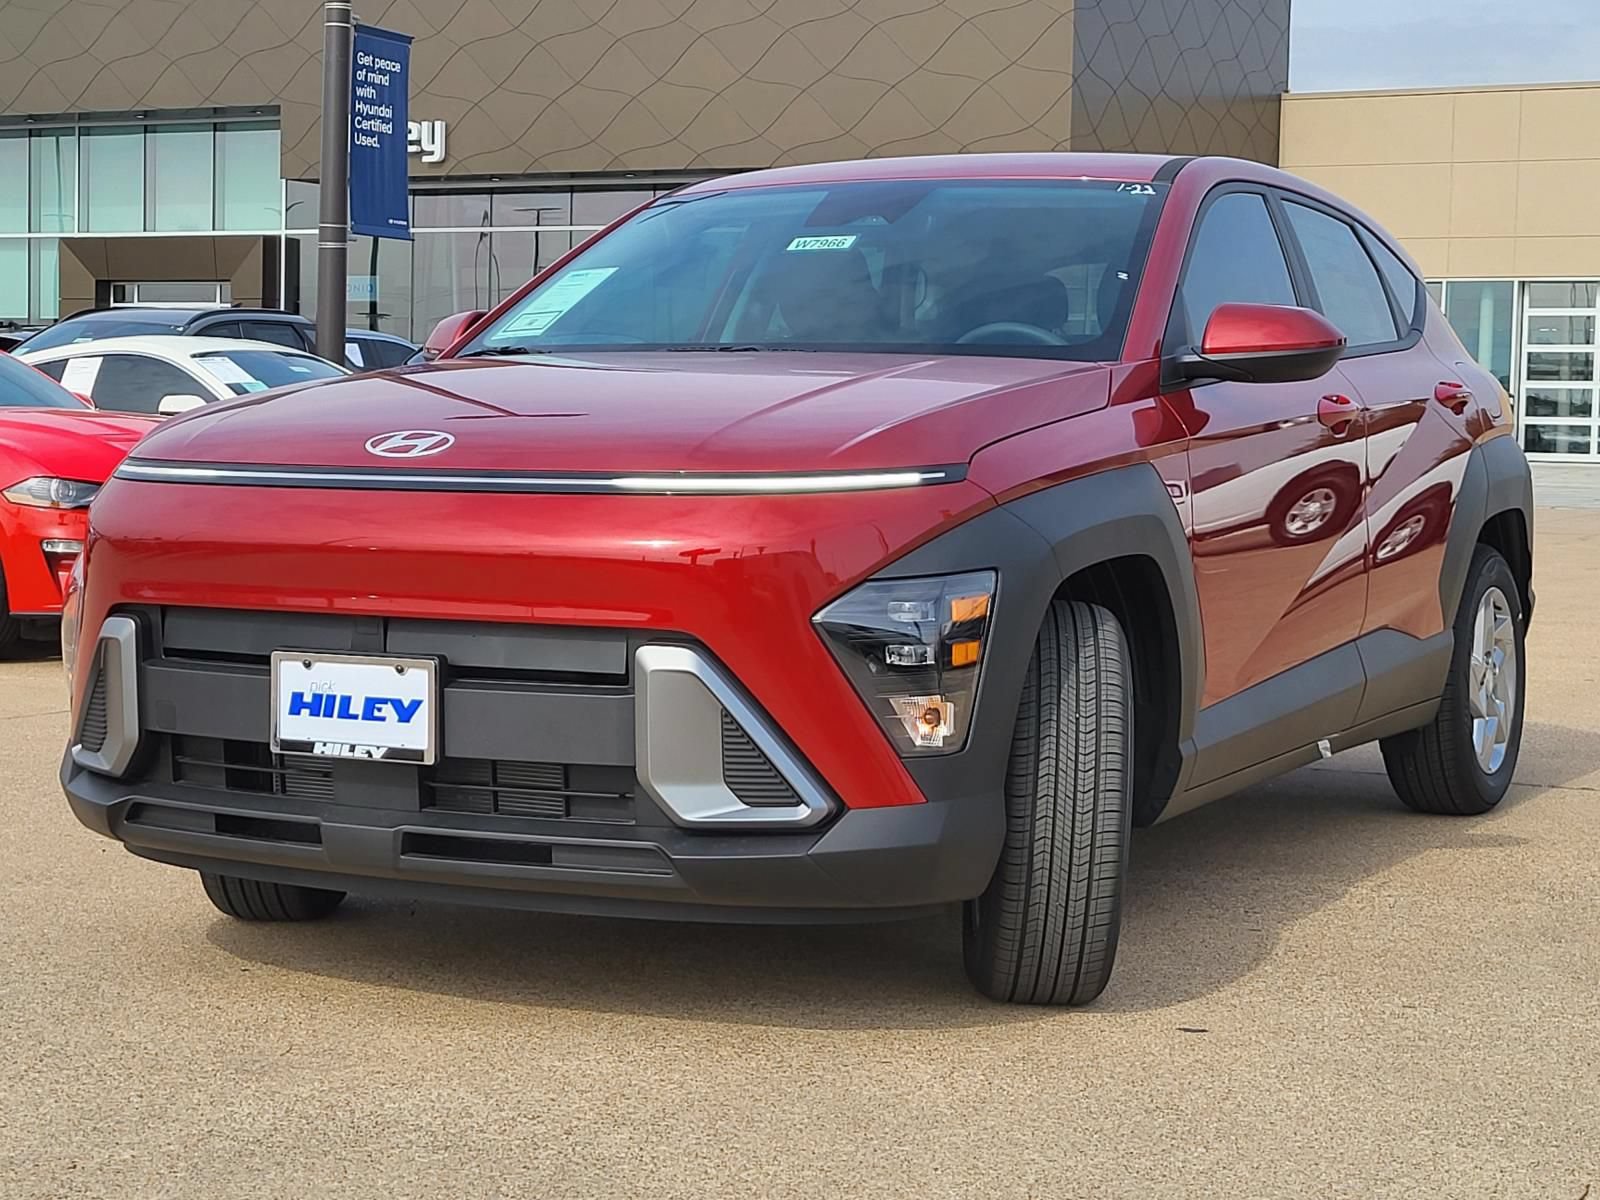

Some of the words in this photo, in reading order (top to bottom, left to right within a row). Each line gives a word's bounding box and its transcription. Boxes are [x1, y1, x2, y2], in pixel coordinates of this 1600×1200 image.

[357, 52, 373, 67] Get
[374, 57, 401, 73] peace
[356, 68, 366, 81] of
[367, 70, 390, 86] mind
[355, 84, 376, 99] with
[355, 99, 393, 119] Hyundai
[354, 116, 393, 135] Certified
[354, 131, 380, 148] Used.
[794, 238, 848, 249] W7966
[288, 691, 425, 723] HILEY
[312, 741, 389, 759] HILEY
